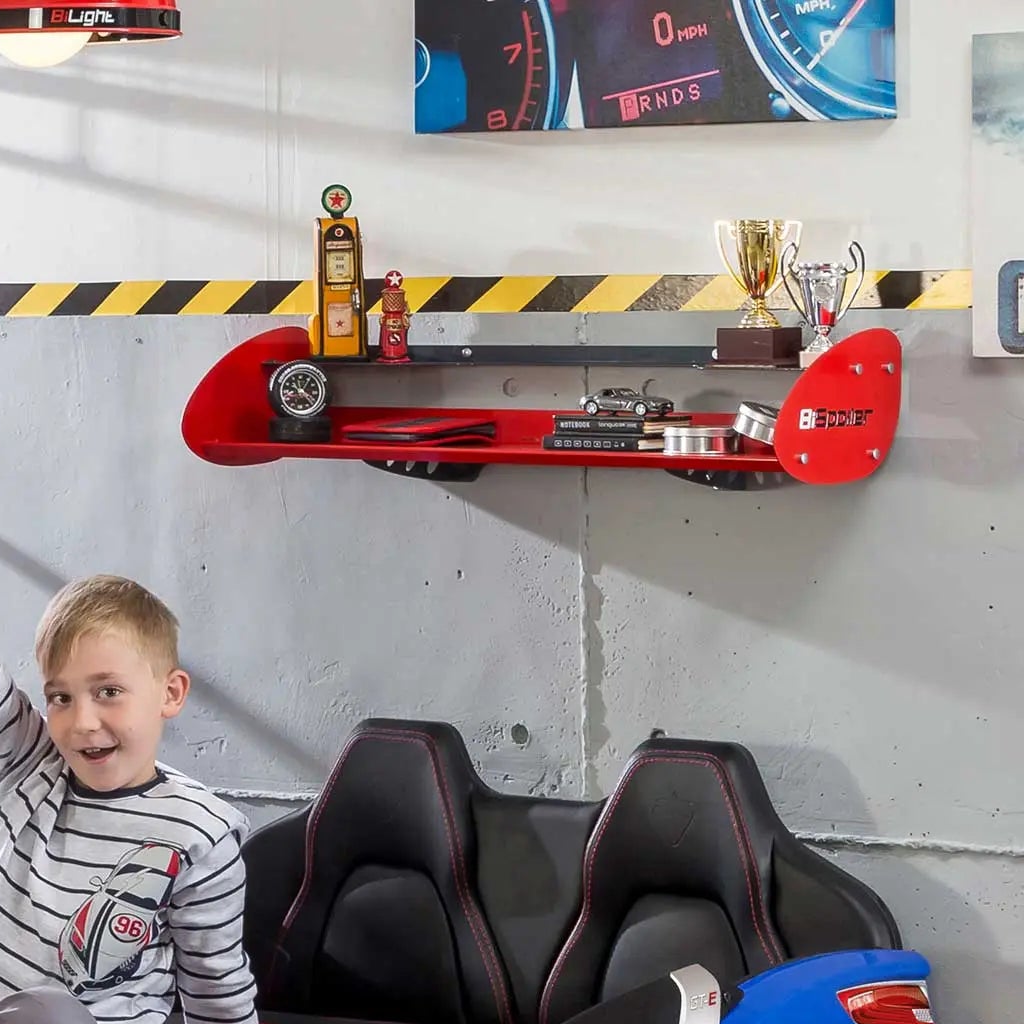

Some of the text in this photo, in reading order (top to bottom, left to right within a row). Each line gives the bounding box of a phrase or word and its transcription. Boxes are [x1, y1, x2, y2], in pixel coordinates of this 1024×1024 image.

[652, 11, 708, 46] 0 MPH
[487, 109, 508, 130] 8
[114, 915, 144, 938] 96
